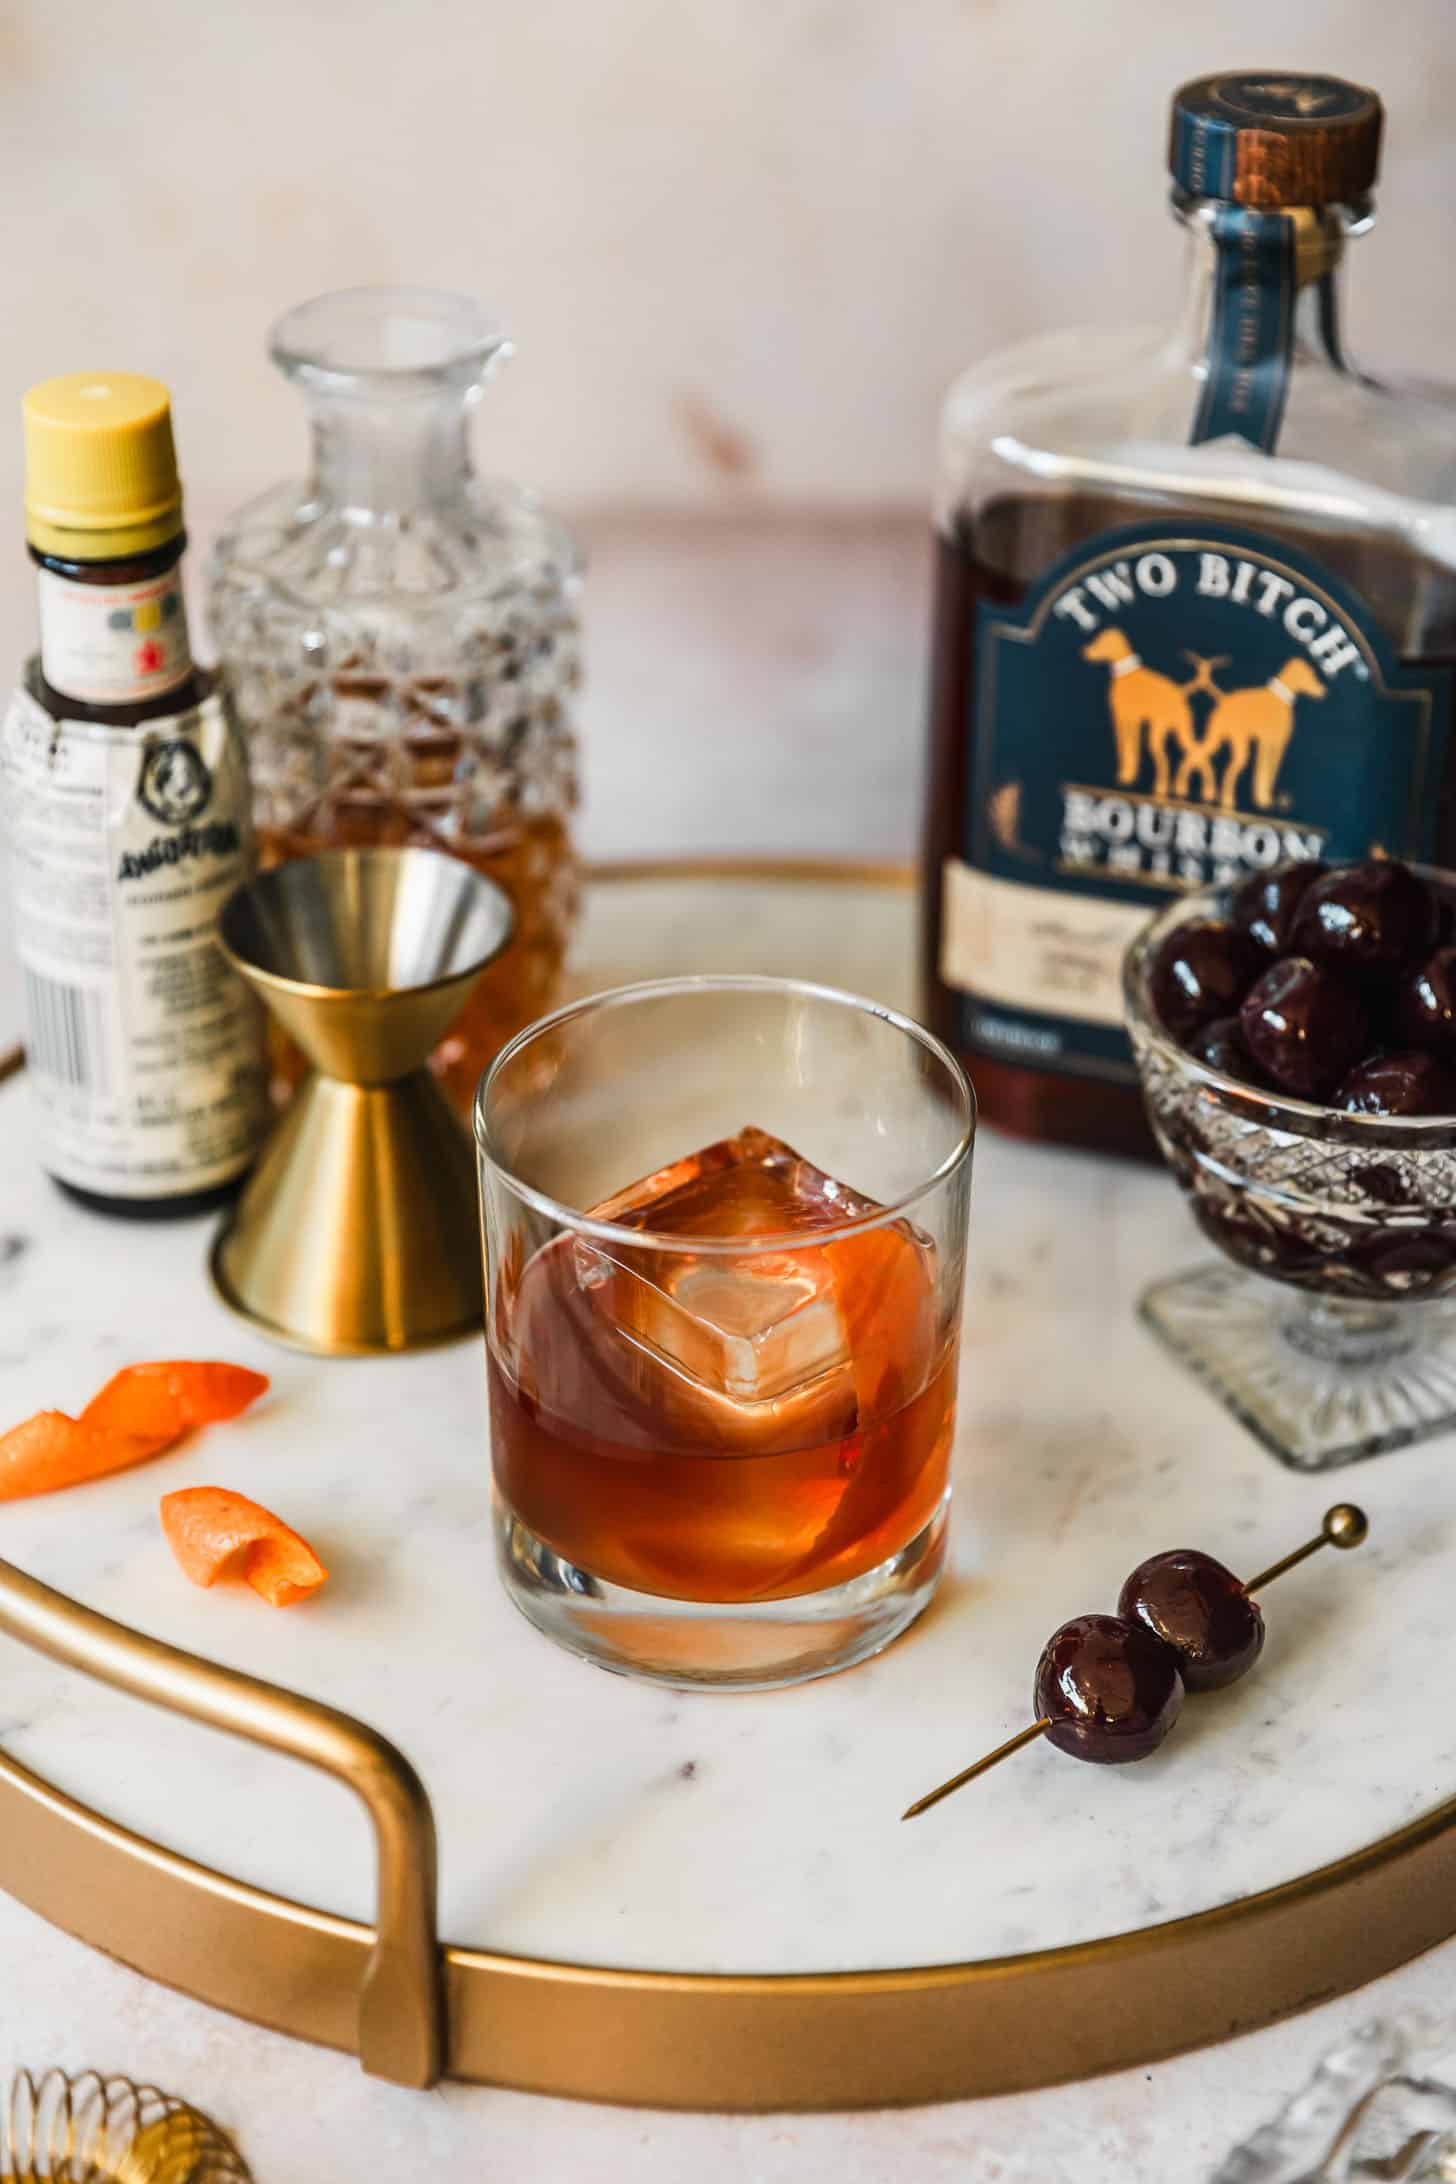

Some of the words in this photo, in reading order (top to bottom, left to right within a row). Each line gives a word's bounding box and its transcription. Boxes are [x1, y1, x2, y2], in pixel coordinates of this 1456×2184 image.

[1053, 553, 1177, 631] TWO
[1196, 553, 1360, 677] BITCH
[1064, 791, 1323, 870] BOURBON
